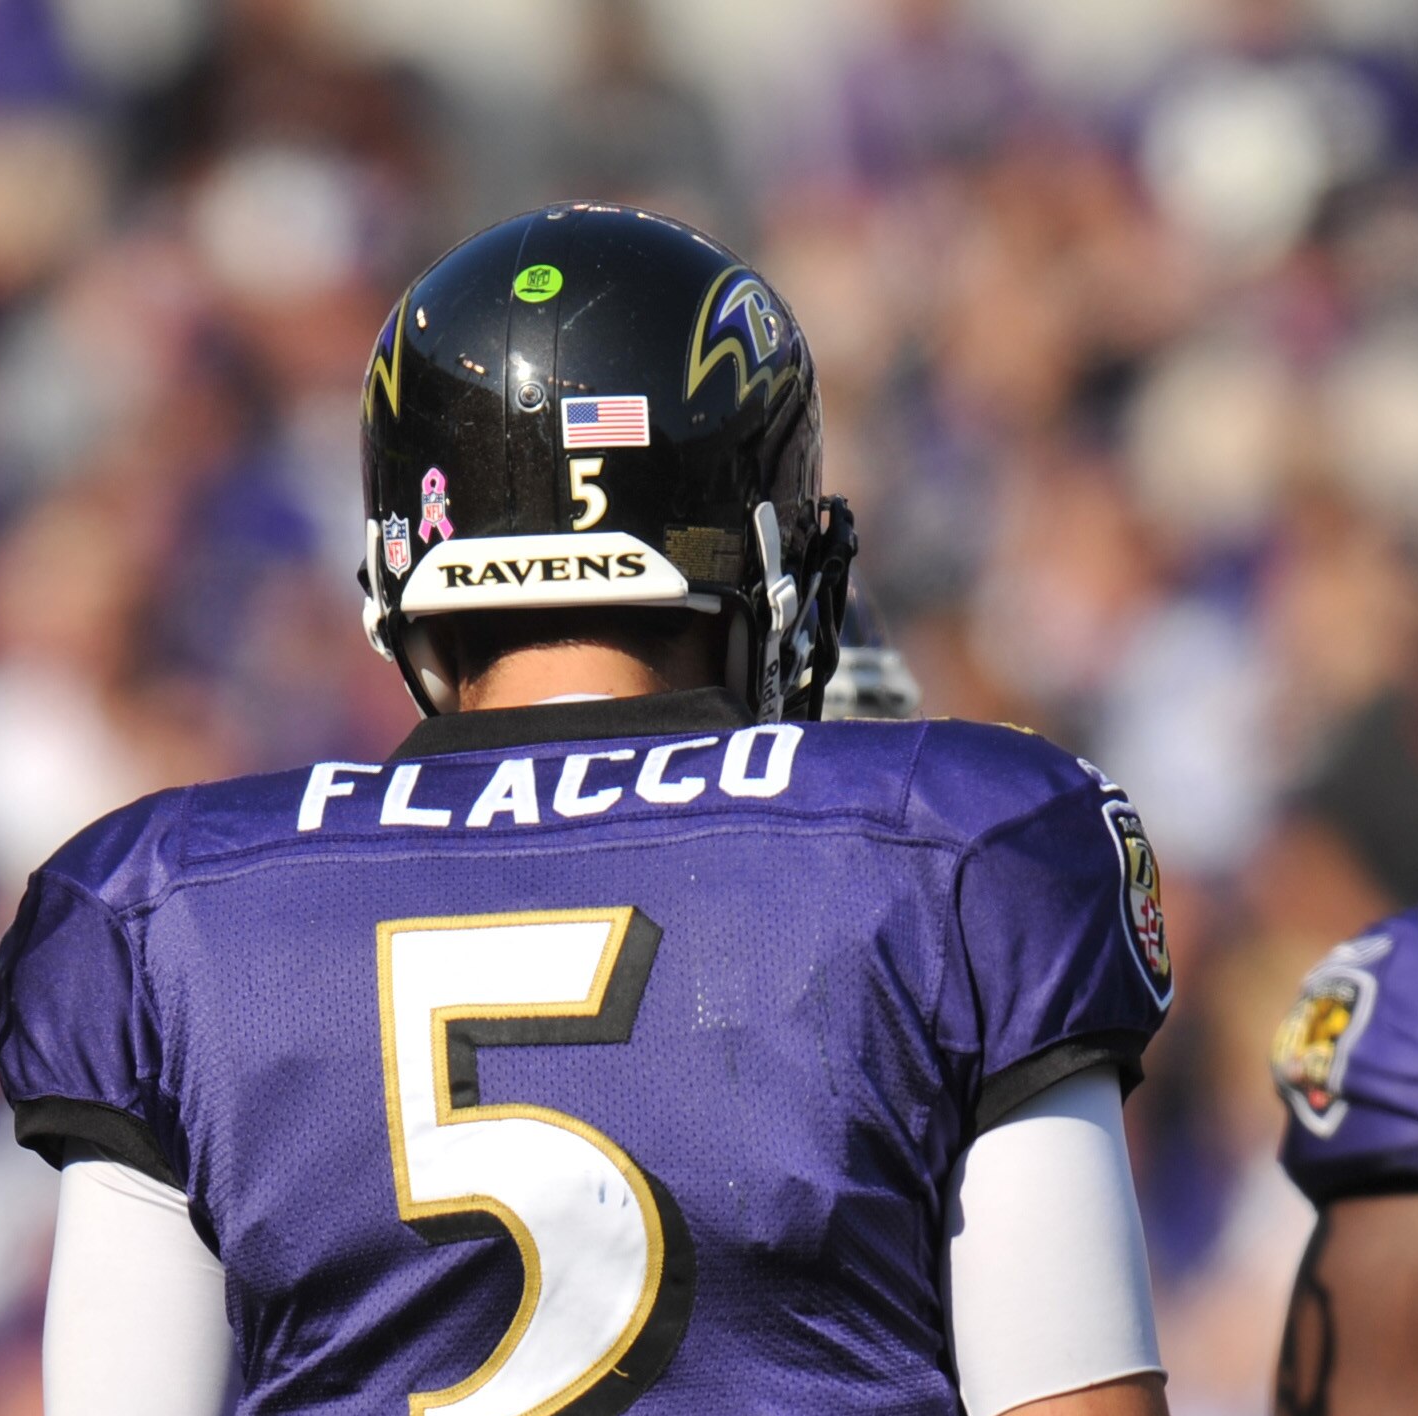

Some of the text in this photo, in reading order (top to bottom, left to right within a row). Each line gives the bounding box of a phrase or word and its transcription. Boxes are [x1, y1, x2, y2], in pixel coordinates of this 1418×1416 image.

[569, 456, 609, 532] 5
[438, 552, 646, 589] RAVENS
[296, 724, 805, 833] FLACCO
